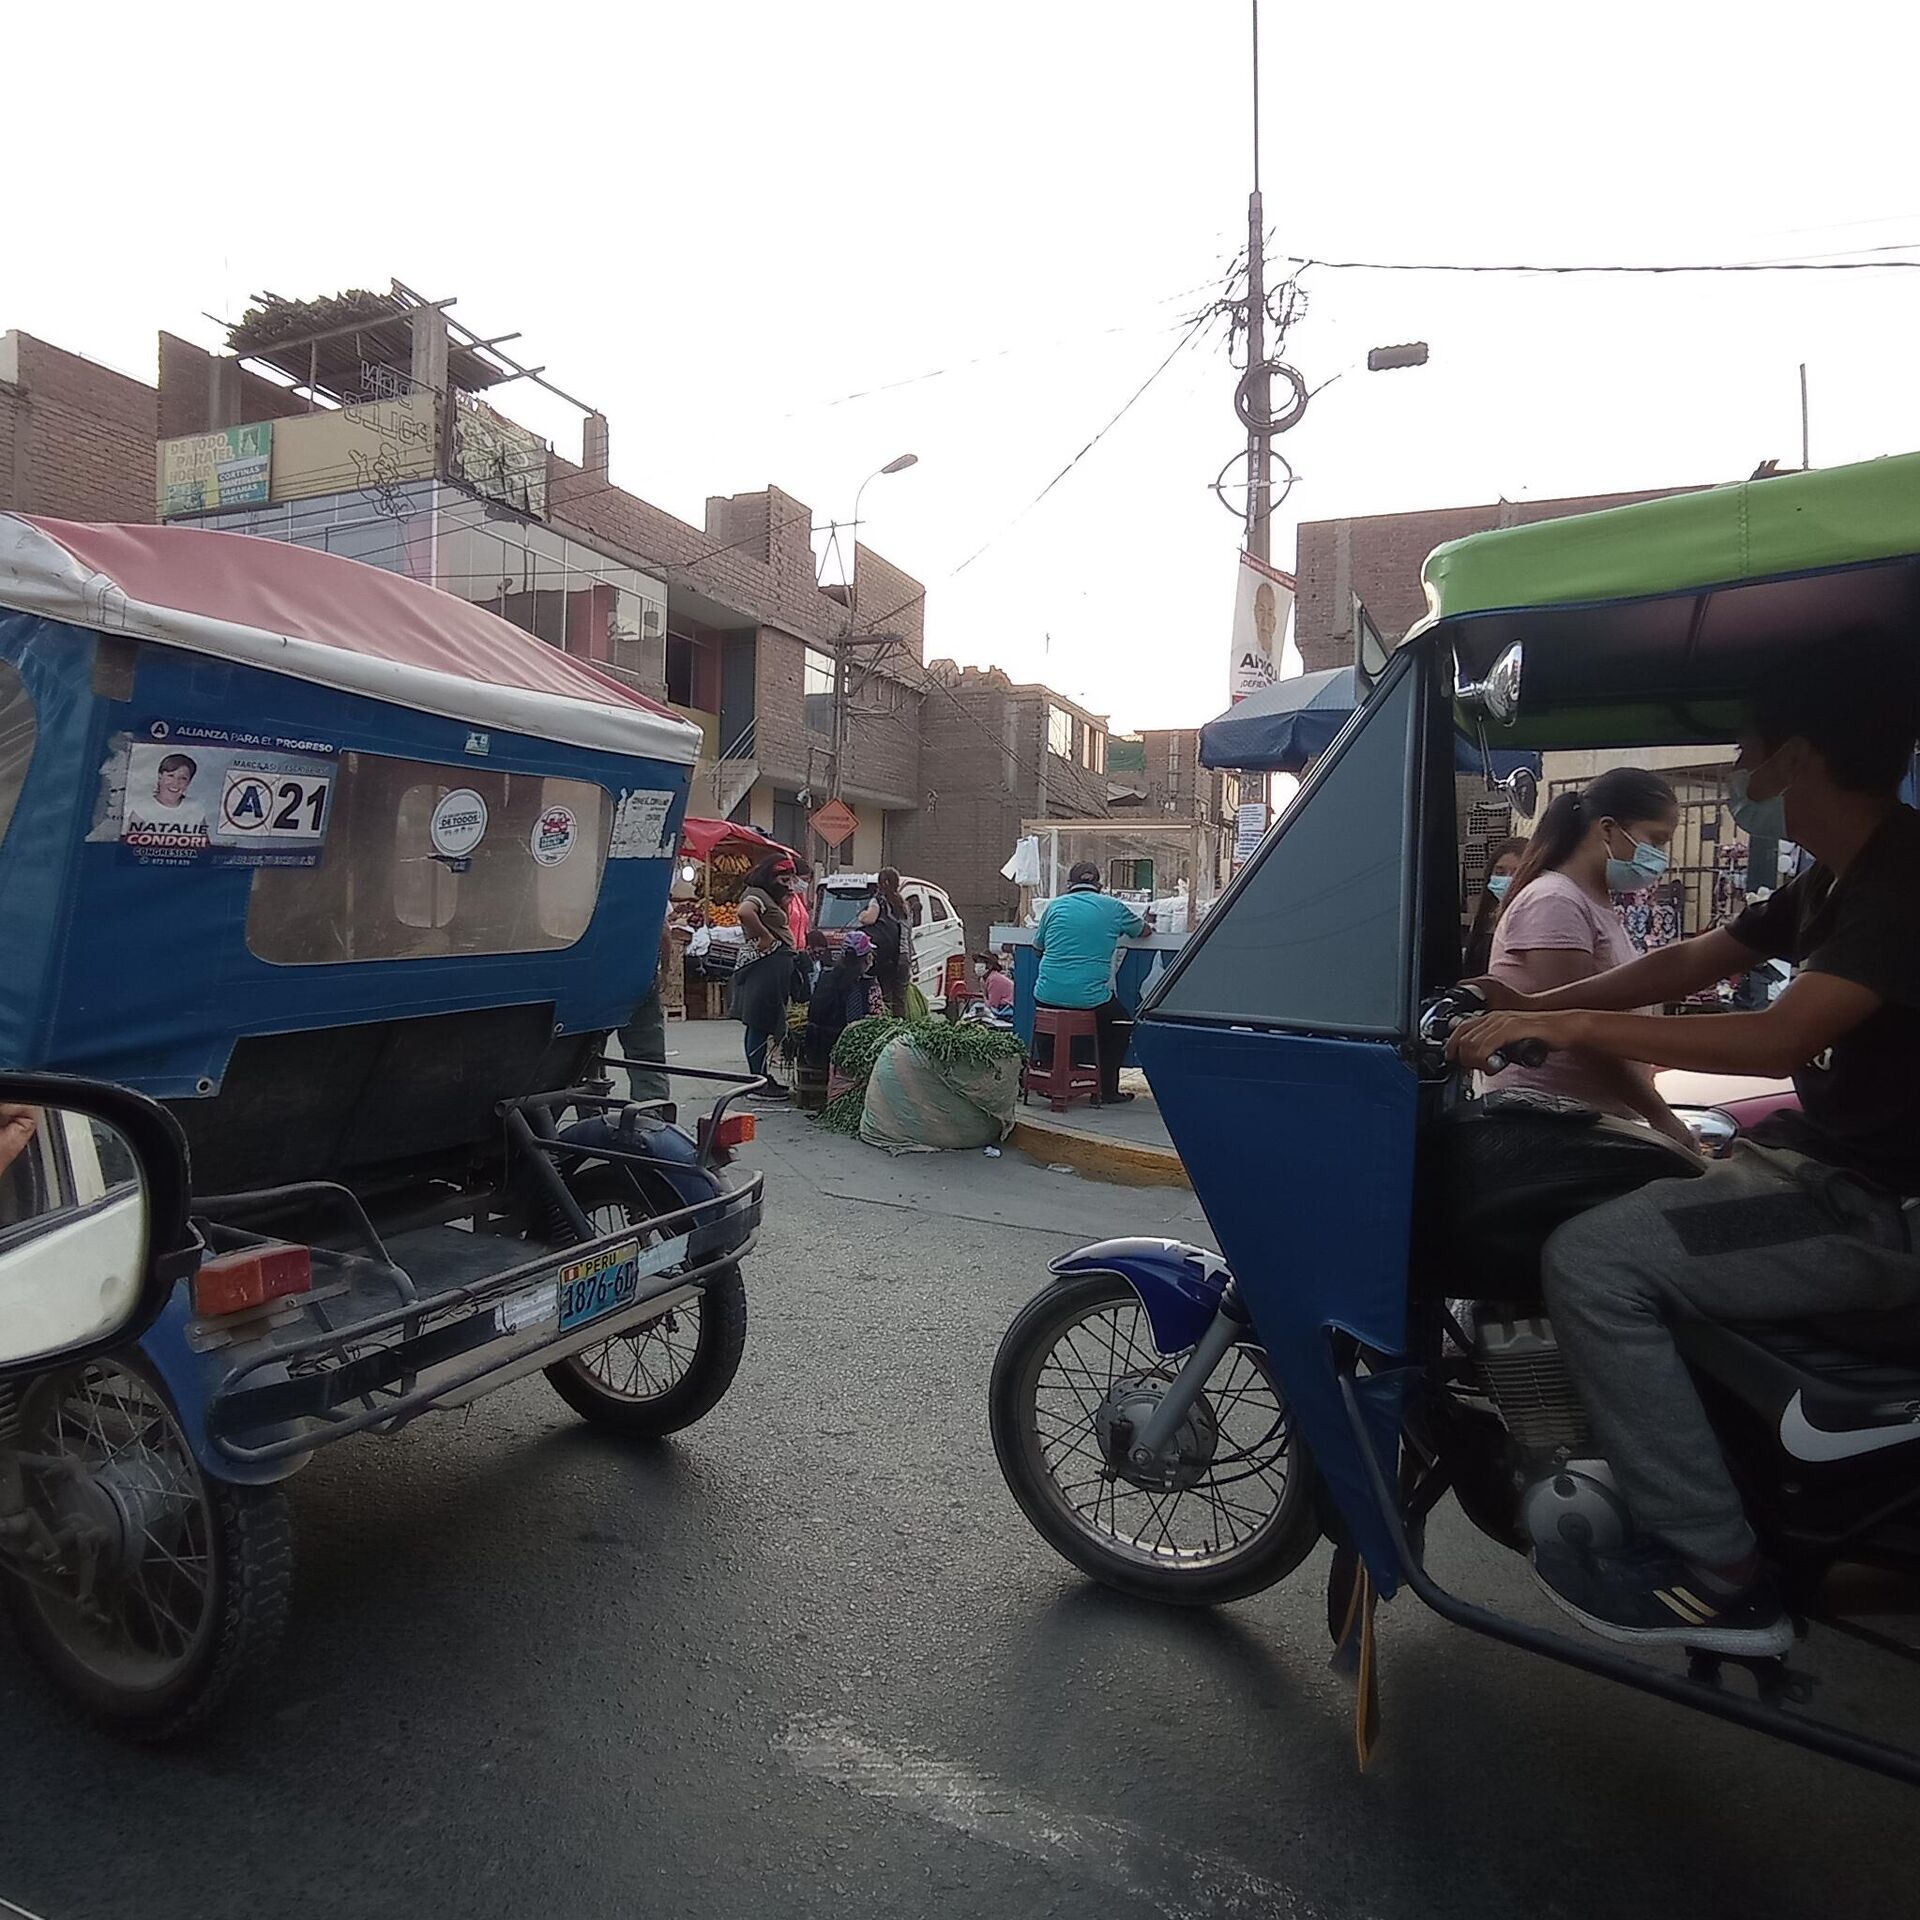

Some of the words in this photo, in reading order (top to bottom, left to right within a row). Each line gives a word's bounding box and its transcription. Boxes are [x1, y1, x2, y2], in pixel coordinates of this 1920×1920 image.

[219, 466, 260, 481] CORTINAS
[176, 725, 230, 742] ALIANZA
[230, 732, 261, 745] PARA
[261, 736, 273, 746] EL
[275, 737, 334, 753] PROGRESO
[232, 784, 264, 818] A
[272, 782, 327, 831] 21
[128, 821, 210, 836] NATALIE
[126, 833, 208, 848] CONDORI
[133, 846, 198, 858] CONGRESISTA
[585, 1252, 617, 1275] PERU
